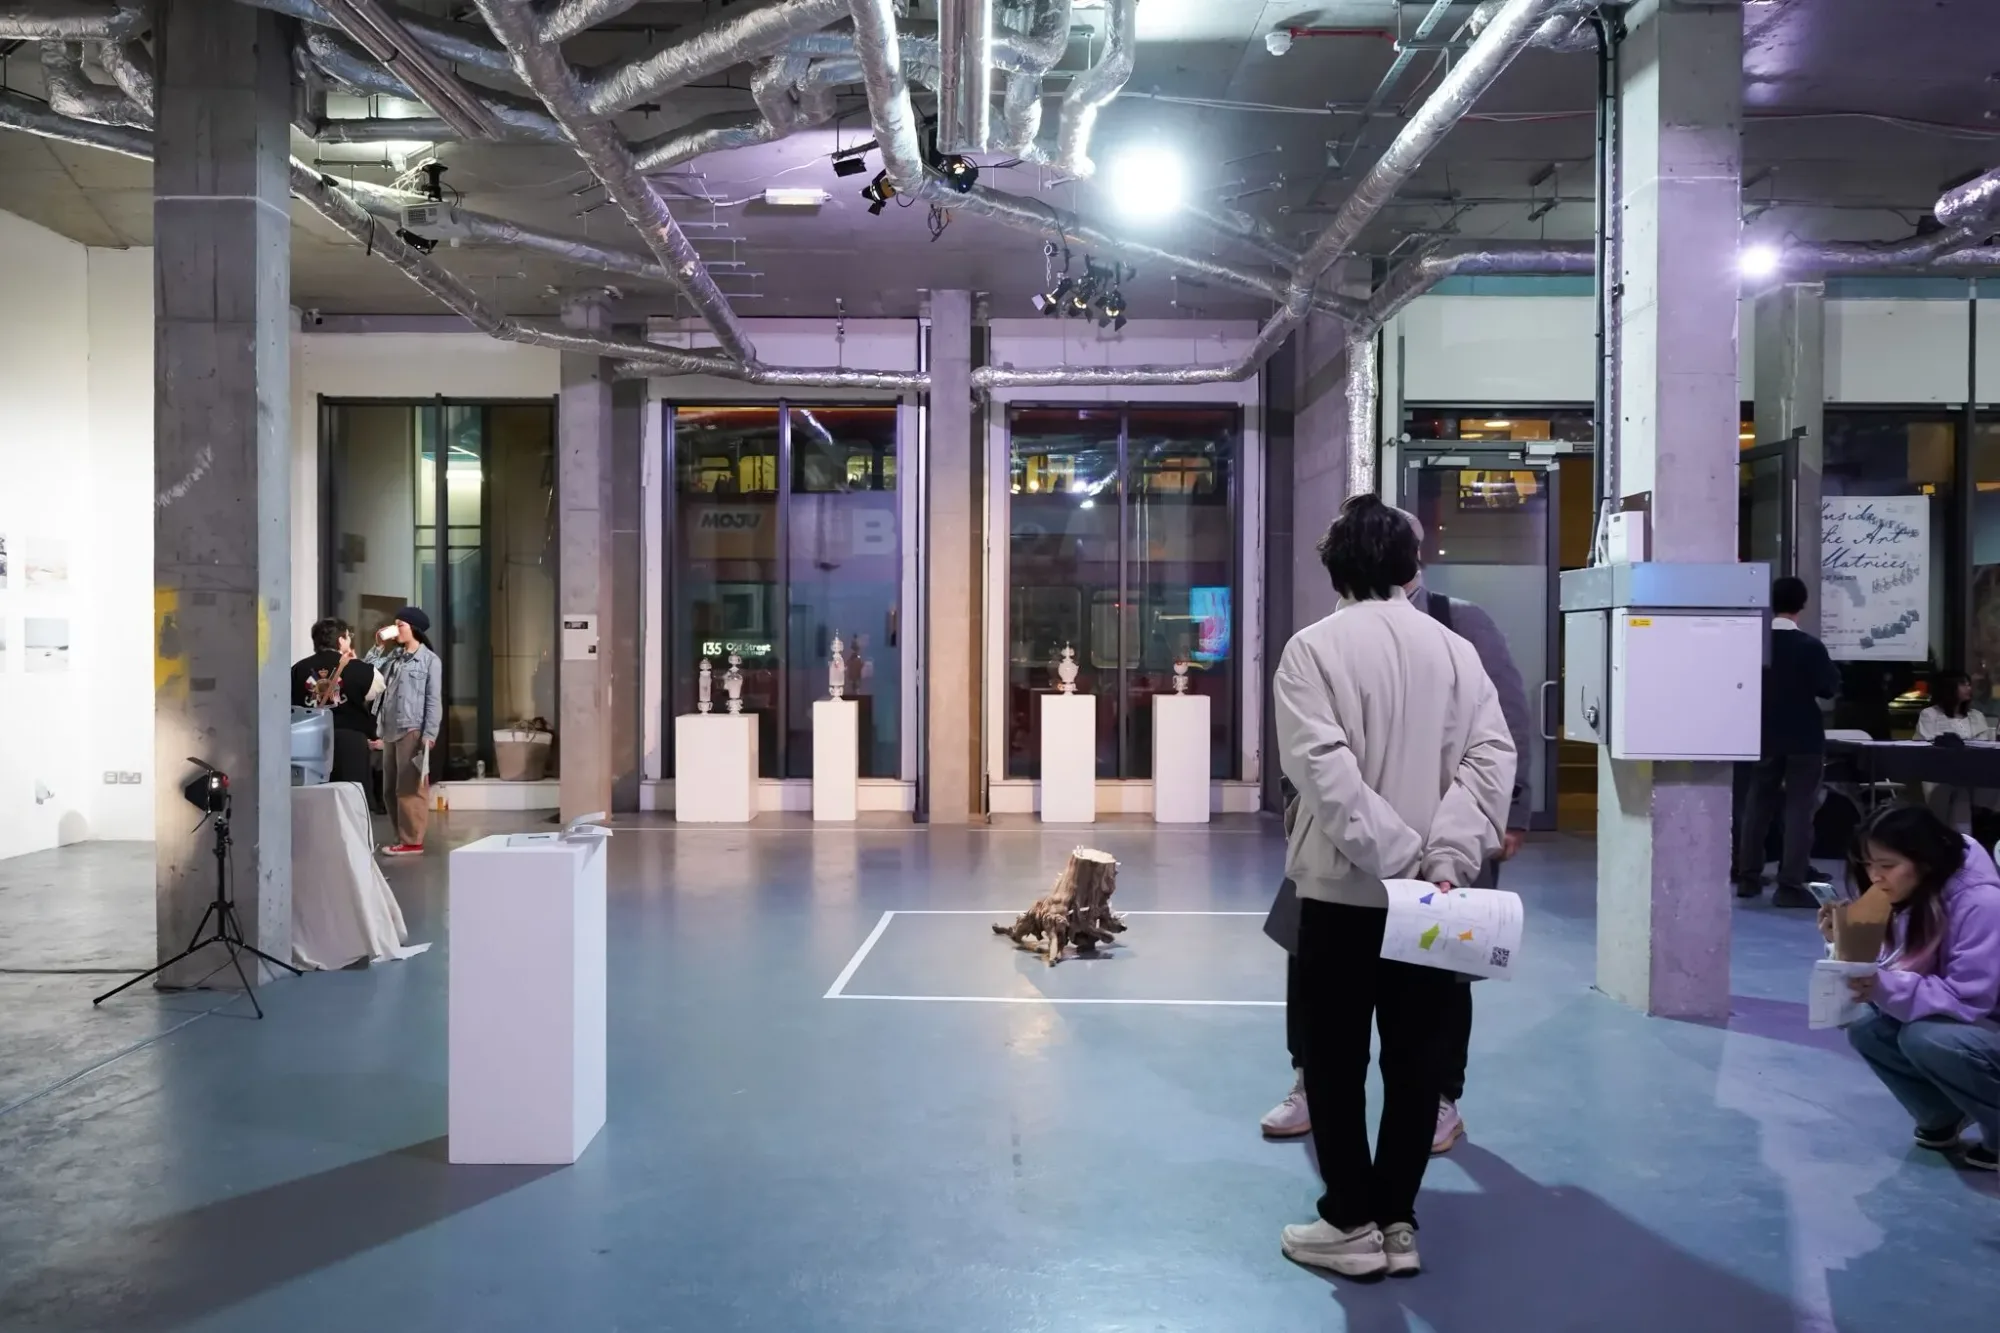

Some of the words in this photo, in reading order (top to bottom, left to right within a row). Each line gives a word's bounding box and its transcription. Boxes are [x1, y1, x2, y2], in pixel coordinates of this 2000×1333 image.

[701, 512, 762, 529] MOJU
[1822, 525, 1846, 544] he
[702, 642, 722, 655] 135
[744, 643, 772, 652] Street
